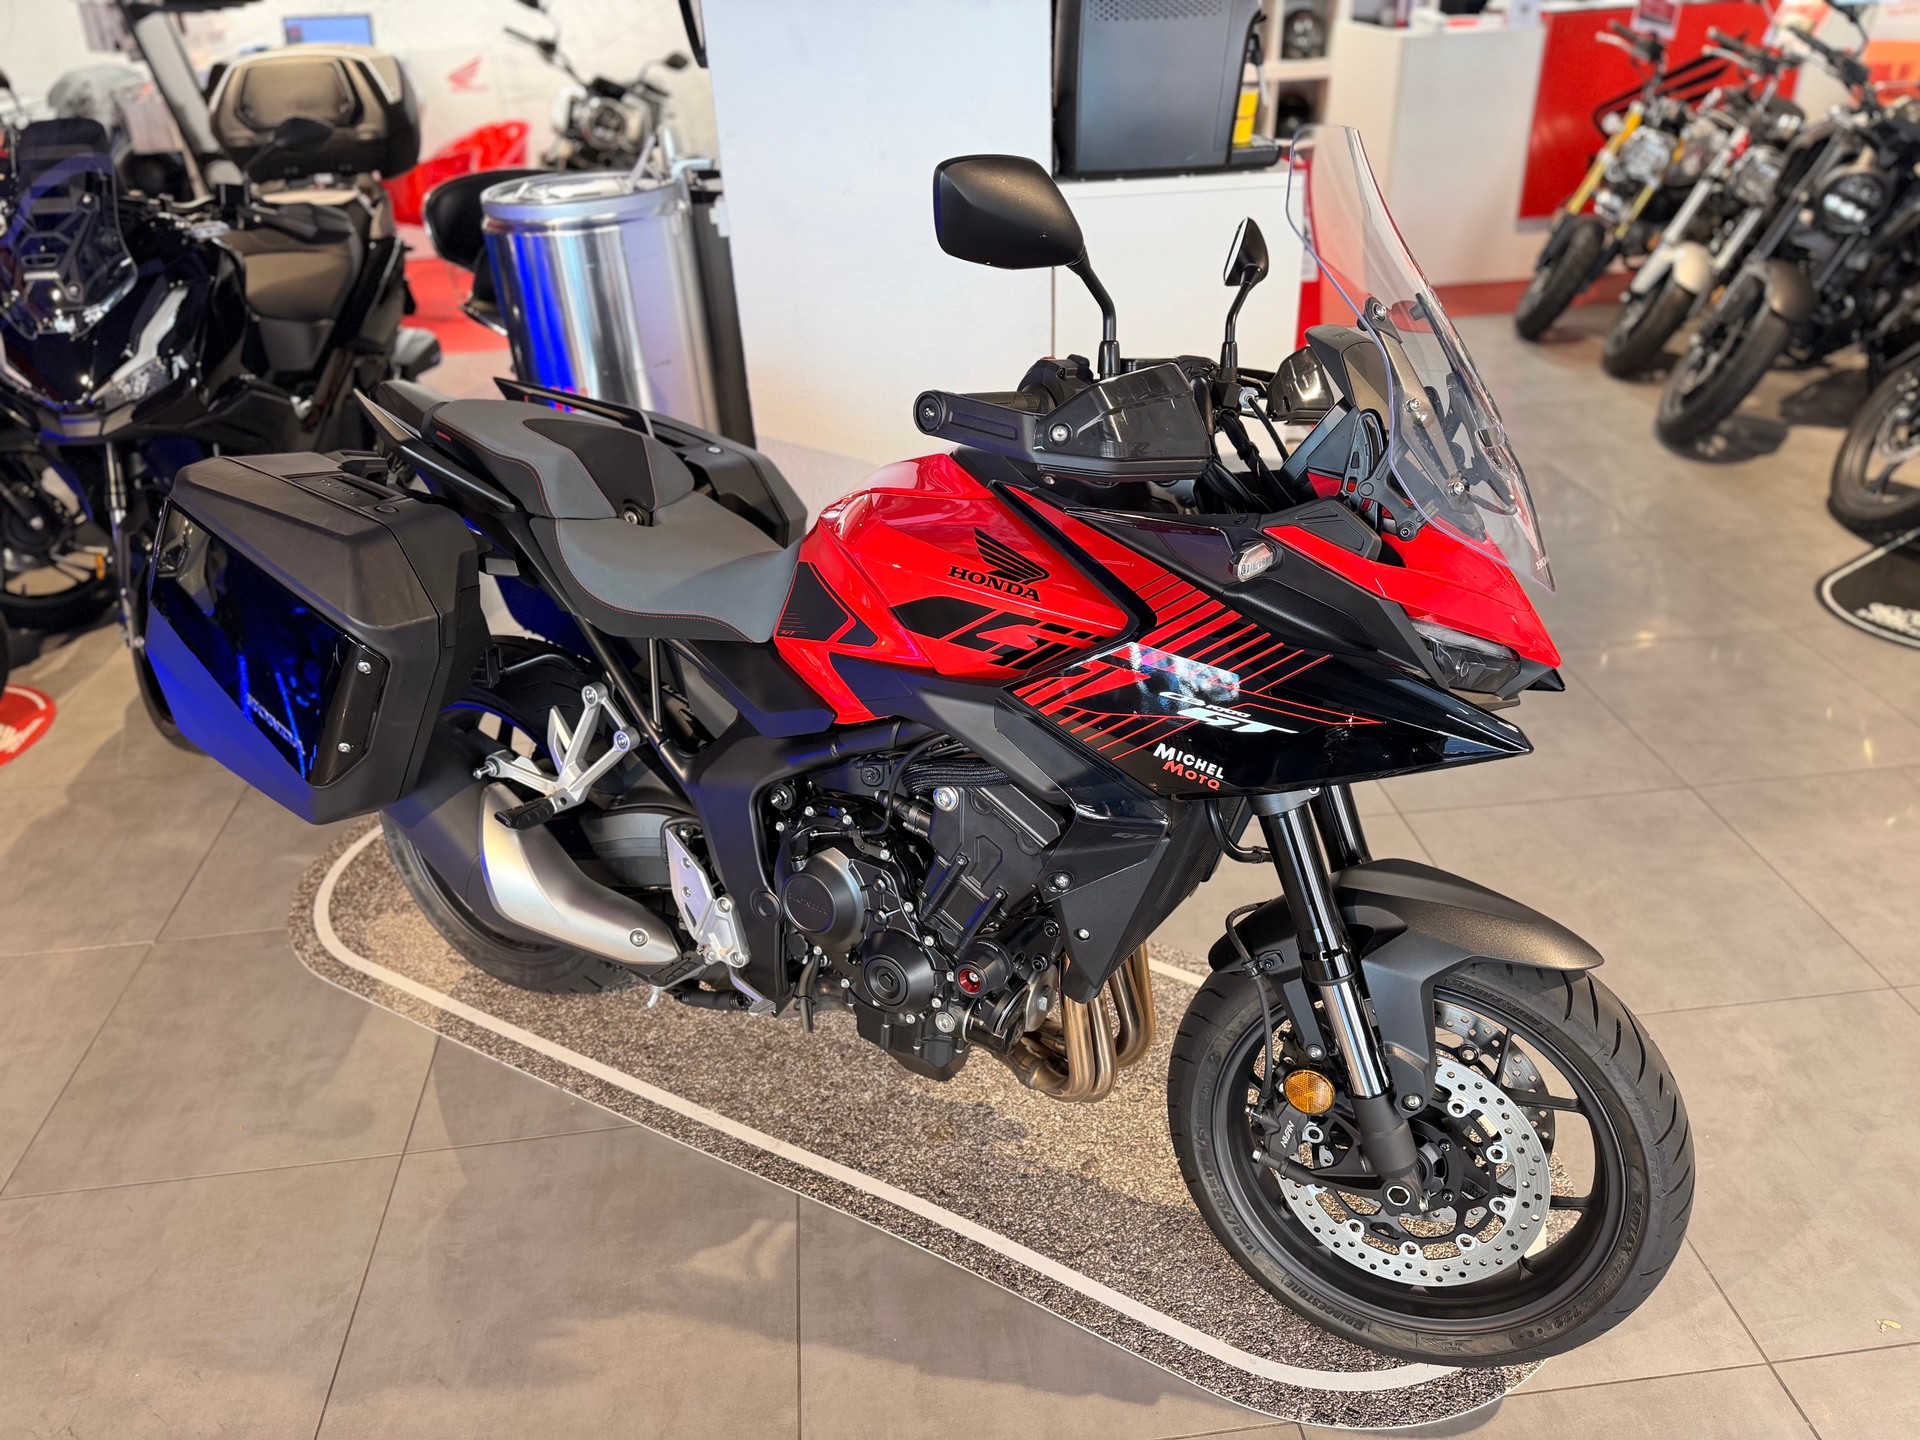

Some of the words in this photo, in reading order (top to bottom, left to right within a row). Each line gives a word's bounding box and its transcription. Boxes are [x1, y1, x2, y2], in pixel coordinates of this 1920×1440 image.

[947, 565, 1041, 602] HONDA
[246, 692, 306, 755] HONDA
[1176, 707, 1300, 734] GT
[1153, 743, 1224, 779] MICHEL
[1283, 1278, 1367, 1331] BRIDGESTONE
